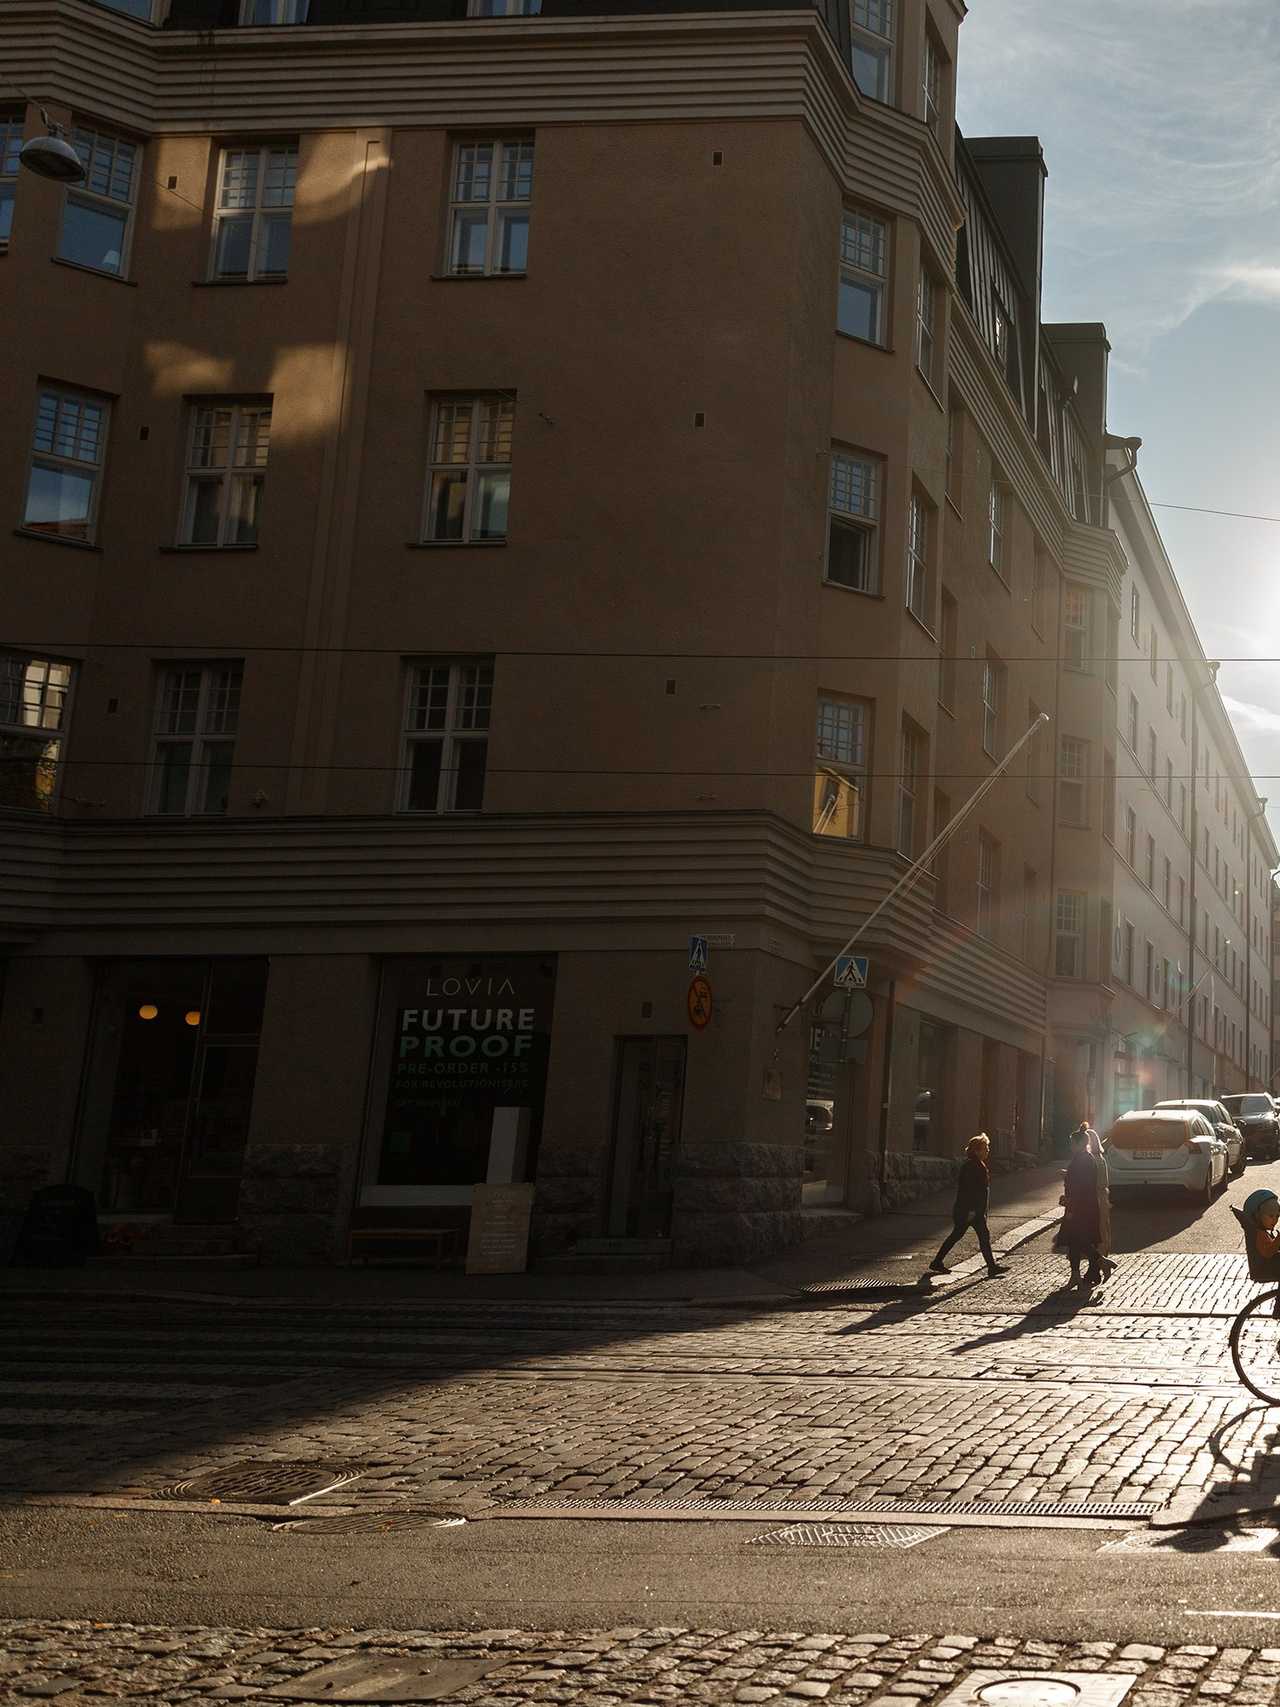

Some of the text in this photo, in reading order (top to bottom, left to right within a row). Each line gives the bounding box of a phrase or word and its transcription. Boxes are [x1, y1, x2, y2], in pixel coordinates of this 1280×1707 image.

[426, 978, 515, 996] LOVIA
[402, 1008, 535, 1031] FUTURE
[398, 1035, 533, 1058] PROOF
[397, 1061, 530, 1075] PRE-ORDER -15%
[395, 1079, 529, 1089] FOR REVOLUTIONISERS
[393, 1099, 461, 1108] GET INSPIRED
